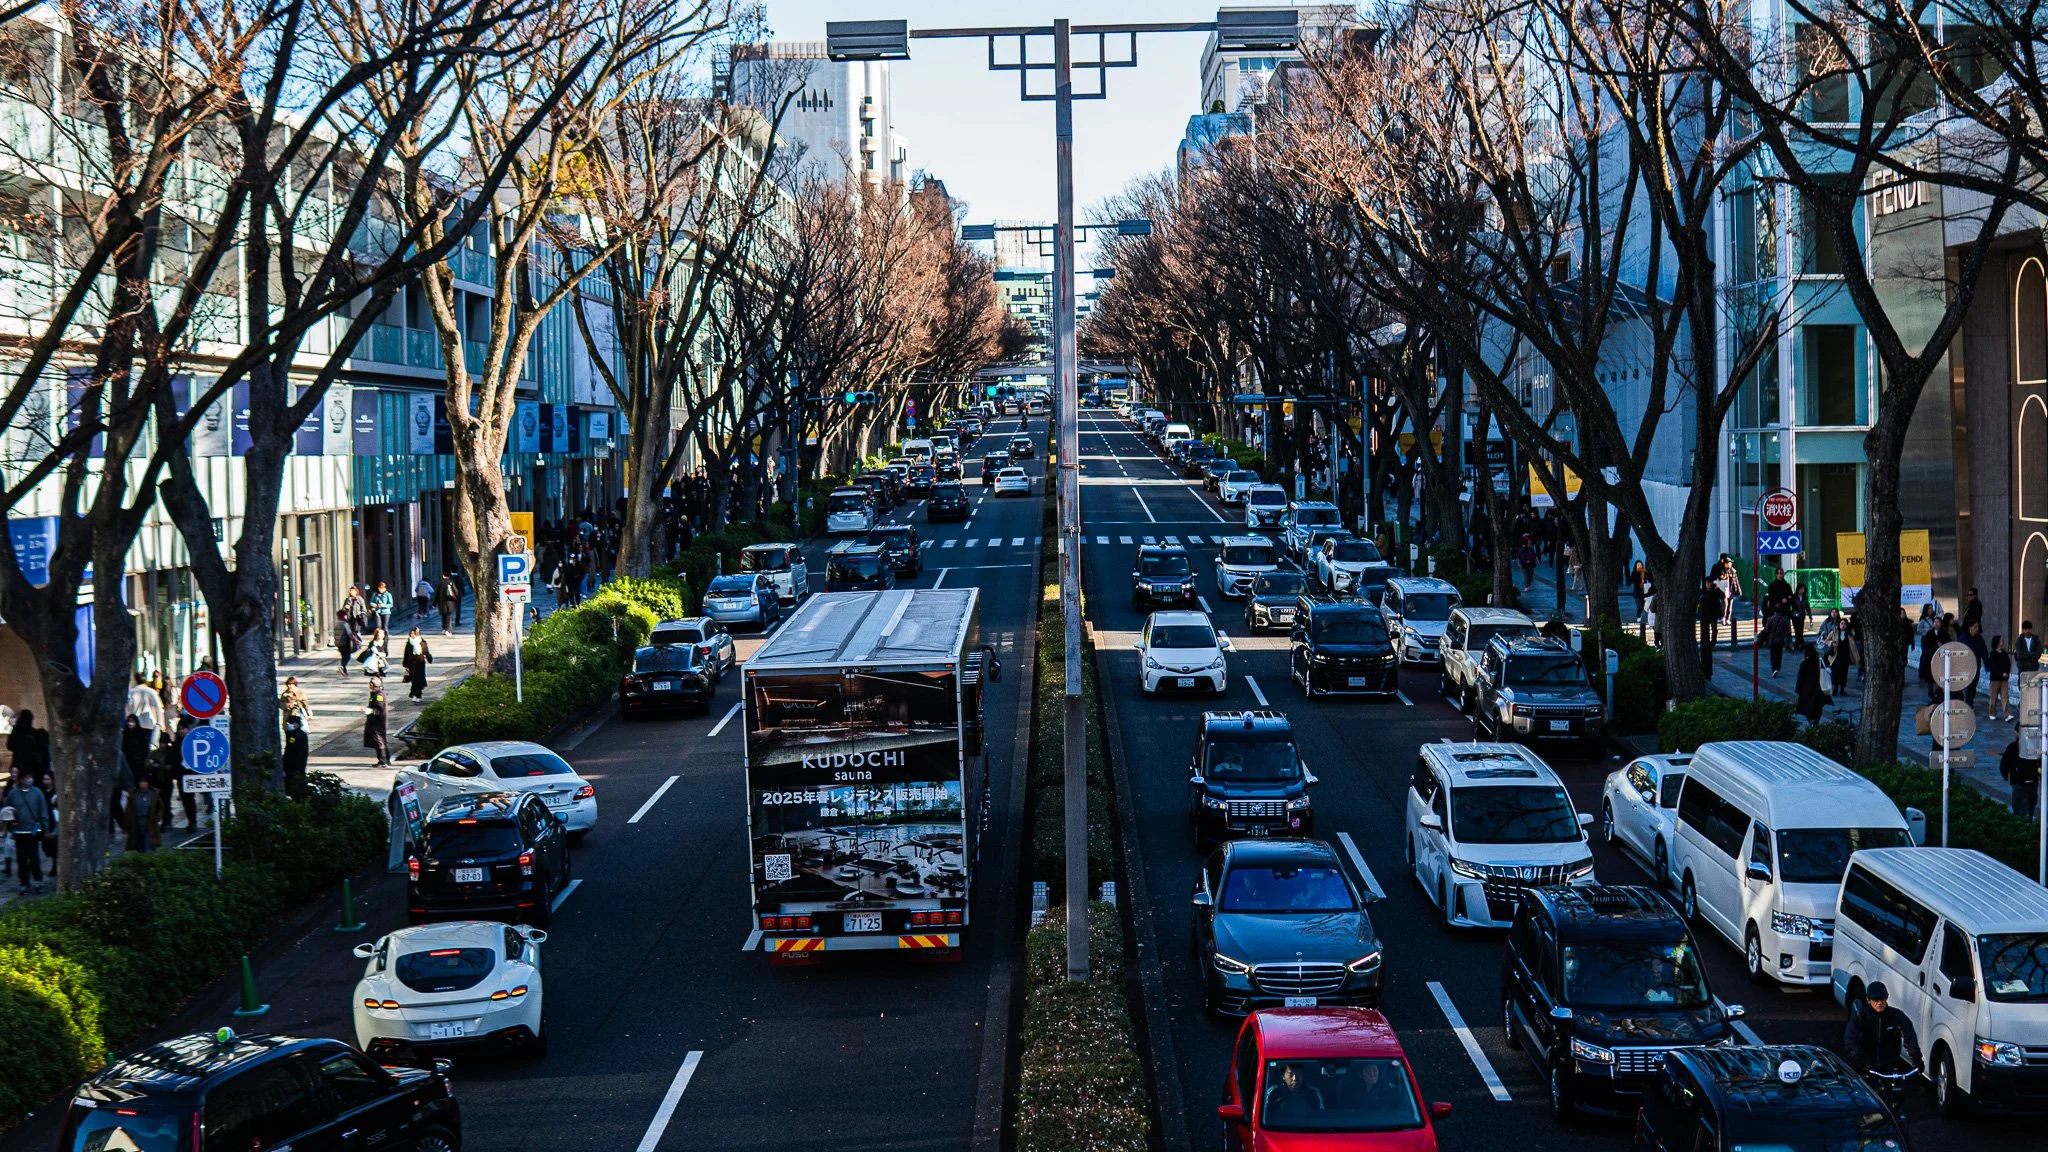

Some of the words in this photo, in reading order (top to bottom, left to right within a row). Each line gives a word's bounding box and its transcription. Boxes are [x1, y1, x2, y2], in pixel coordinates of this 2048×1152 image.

[1872, 158, 1921, 218] FENDI
[1766, 503, 1792, 516] 消火栓
[1846, 557, 1866, 566] FEND
[1901, 555, 1924, 564] FENDI
[501, 556, 526, 583] P
[192, 740, 211, 768] P
[205, 754, 219, 768] 60
[802, 751, 905, 769] KUDOCHI
[834, 770, 873, 781] sauna
[762, 786, 948, 805] 2025年春レジデンス販売開始
